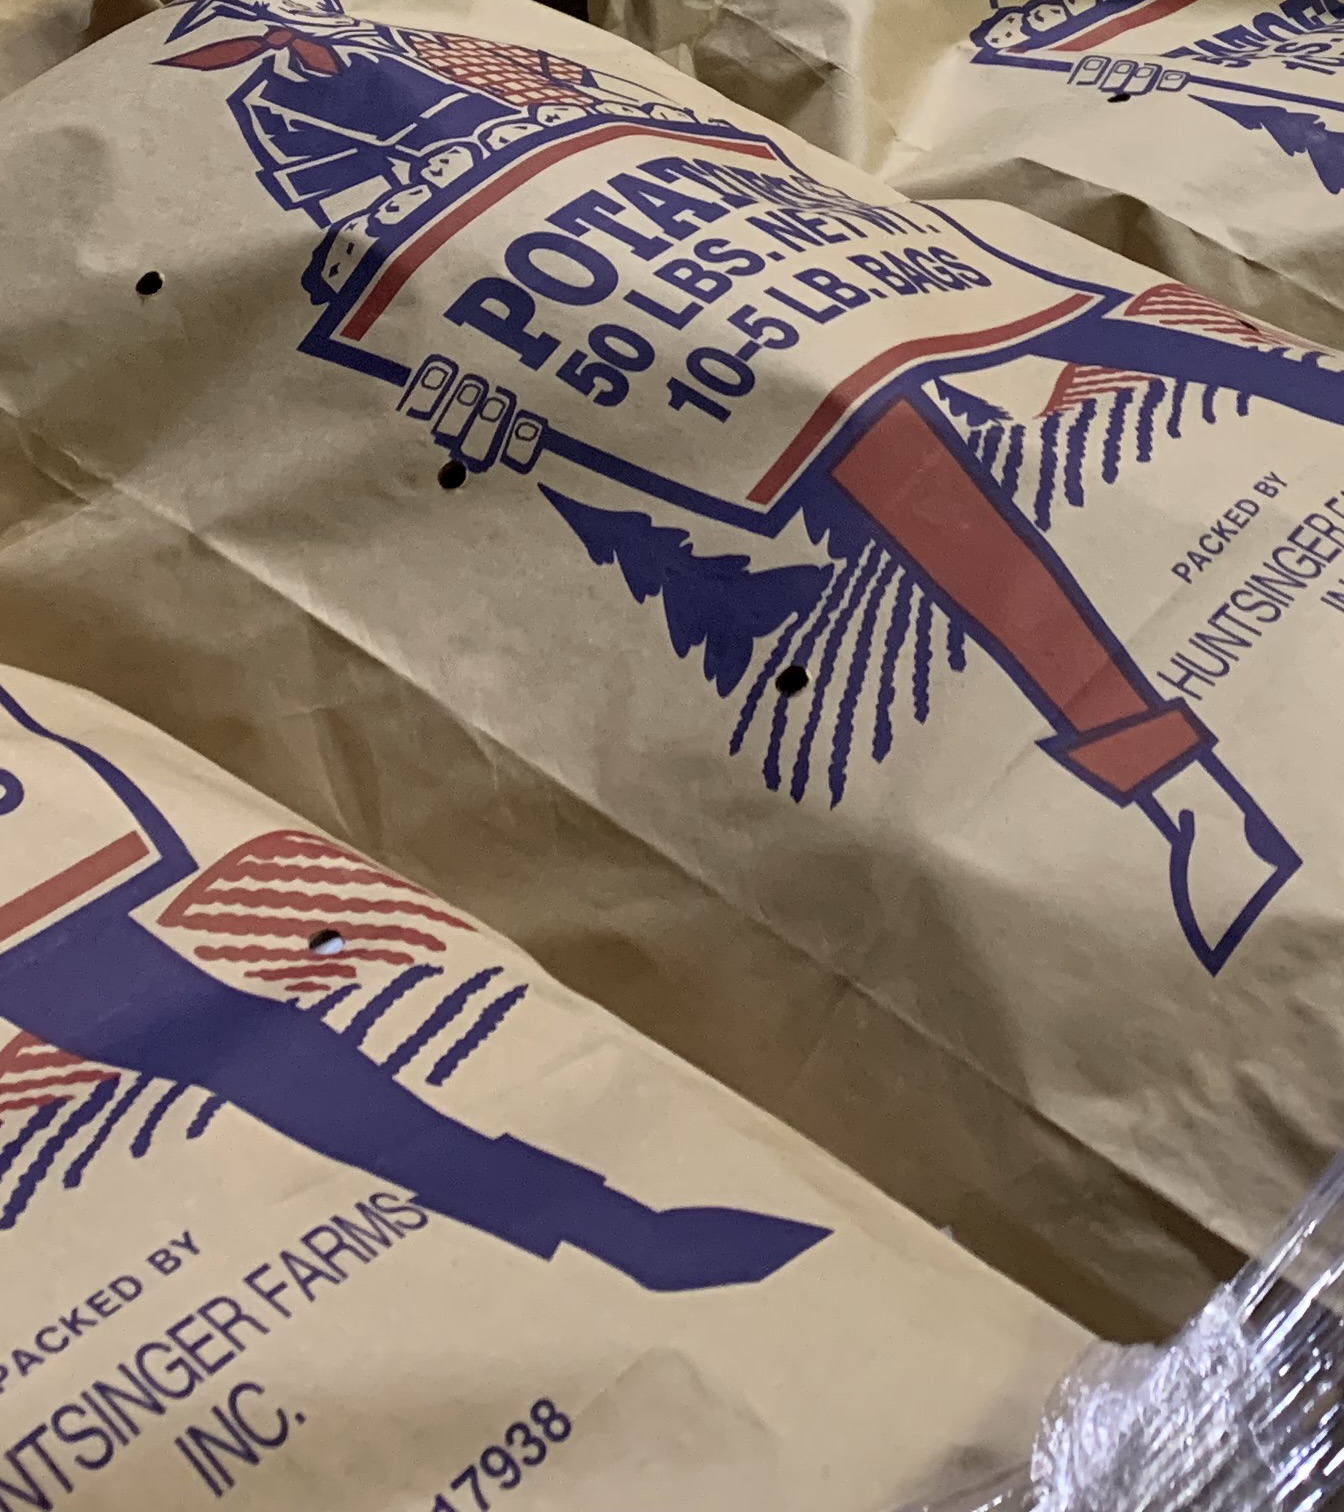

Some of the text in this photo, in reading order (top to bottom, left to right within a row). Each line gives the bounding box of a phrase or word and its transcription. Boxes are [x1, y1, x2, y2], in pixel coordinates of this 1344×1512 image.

[555, 323, 656, 408] 50
[622, 237, 788, 330] LBS.
[667, 245, 993, 423] 10-5 LB. BAGS
[1171, 471, 1289, 585] PACKED BY
[145, 1231, 203, 1277] BY
[242, 1191, 429, 1319] FARMS
[174, 1381, 306, 1498] INC.
